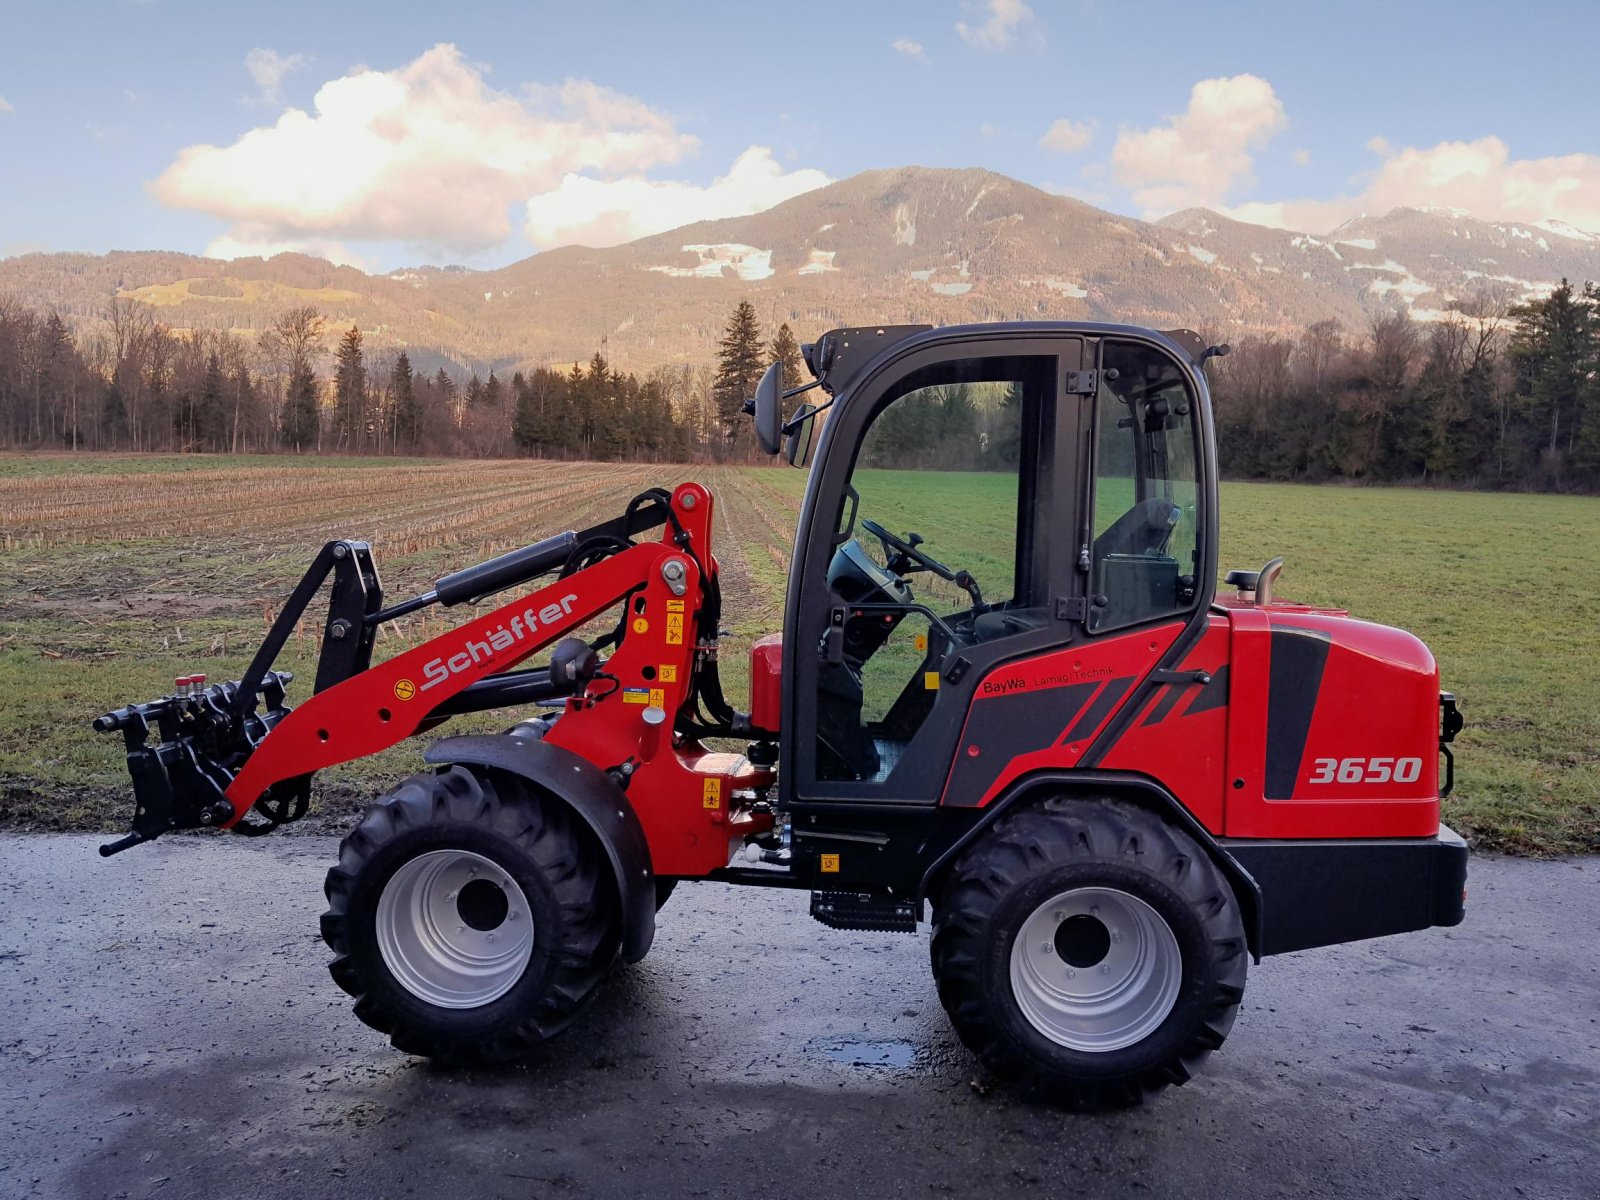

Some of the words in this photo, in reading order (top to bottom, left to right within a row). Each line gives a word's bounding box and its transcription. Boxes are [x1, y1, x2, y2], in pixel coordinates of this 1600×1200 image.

[420, 593, 578, 692] Schäffer
[983, 678, 1026, 694] BayWa
[1309, 757, 1423, 784] 3650
